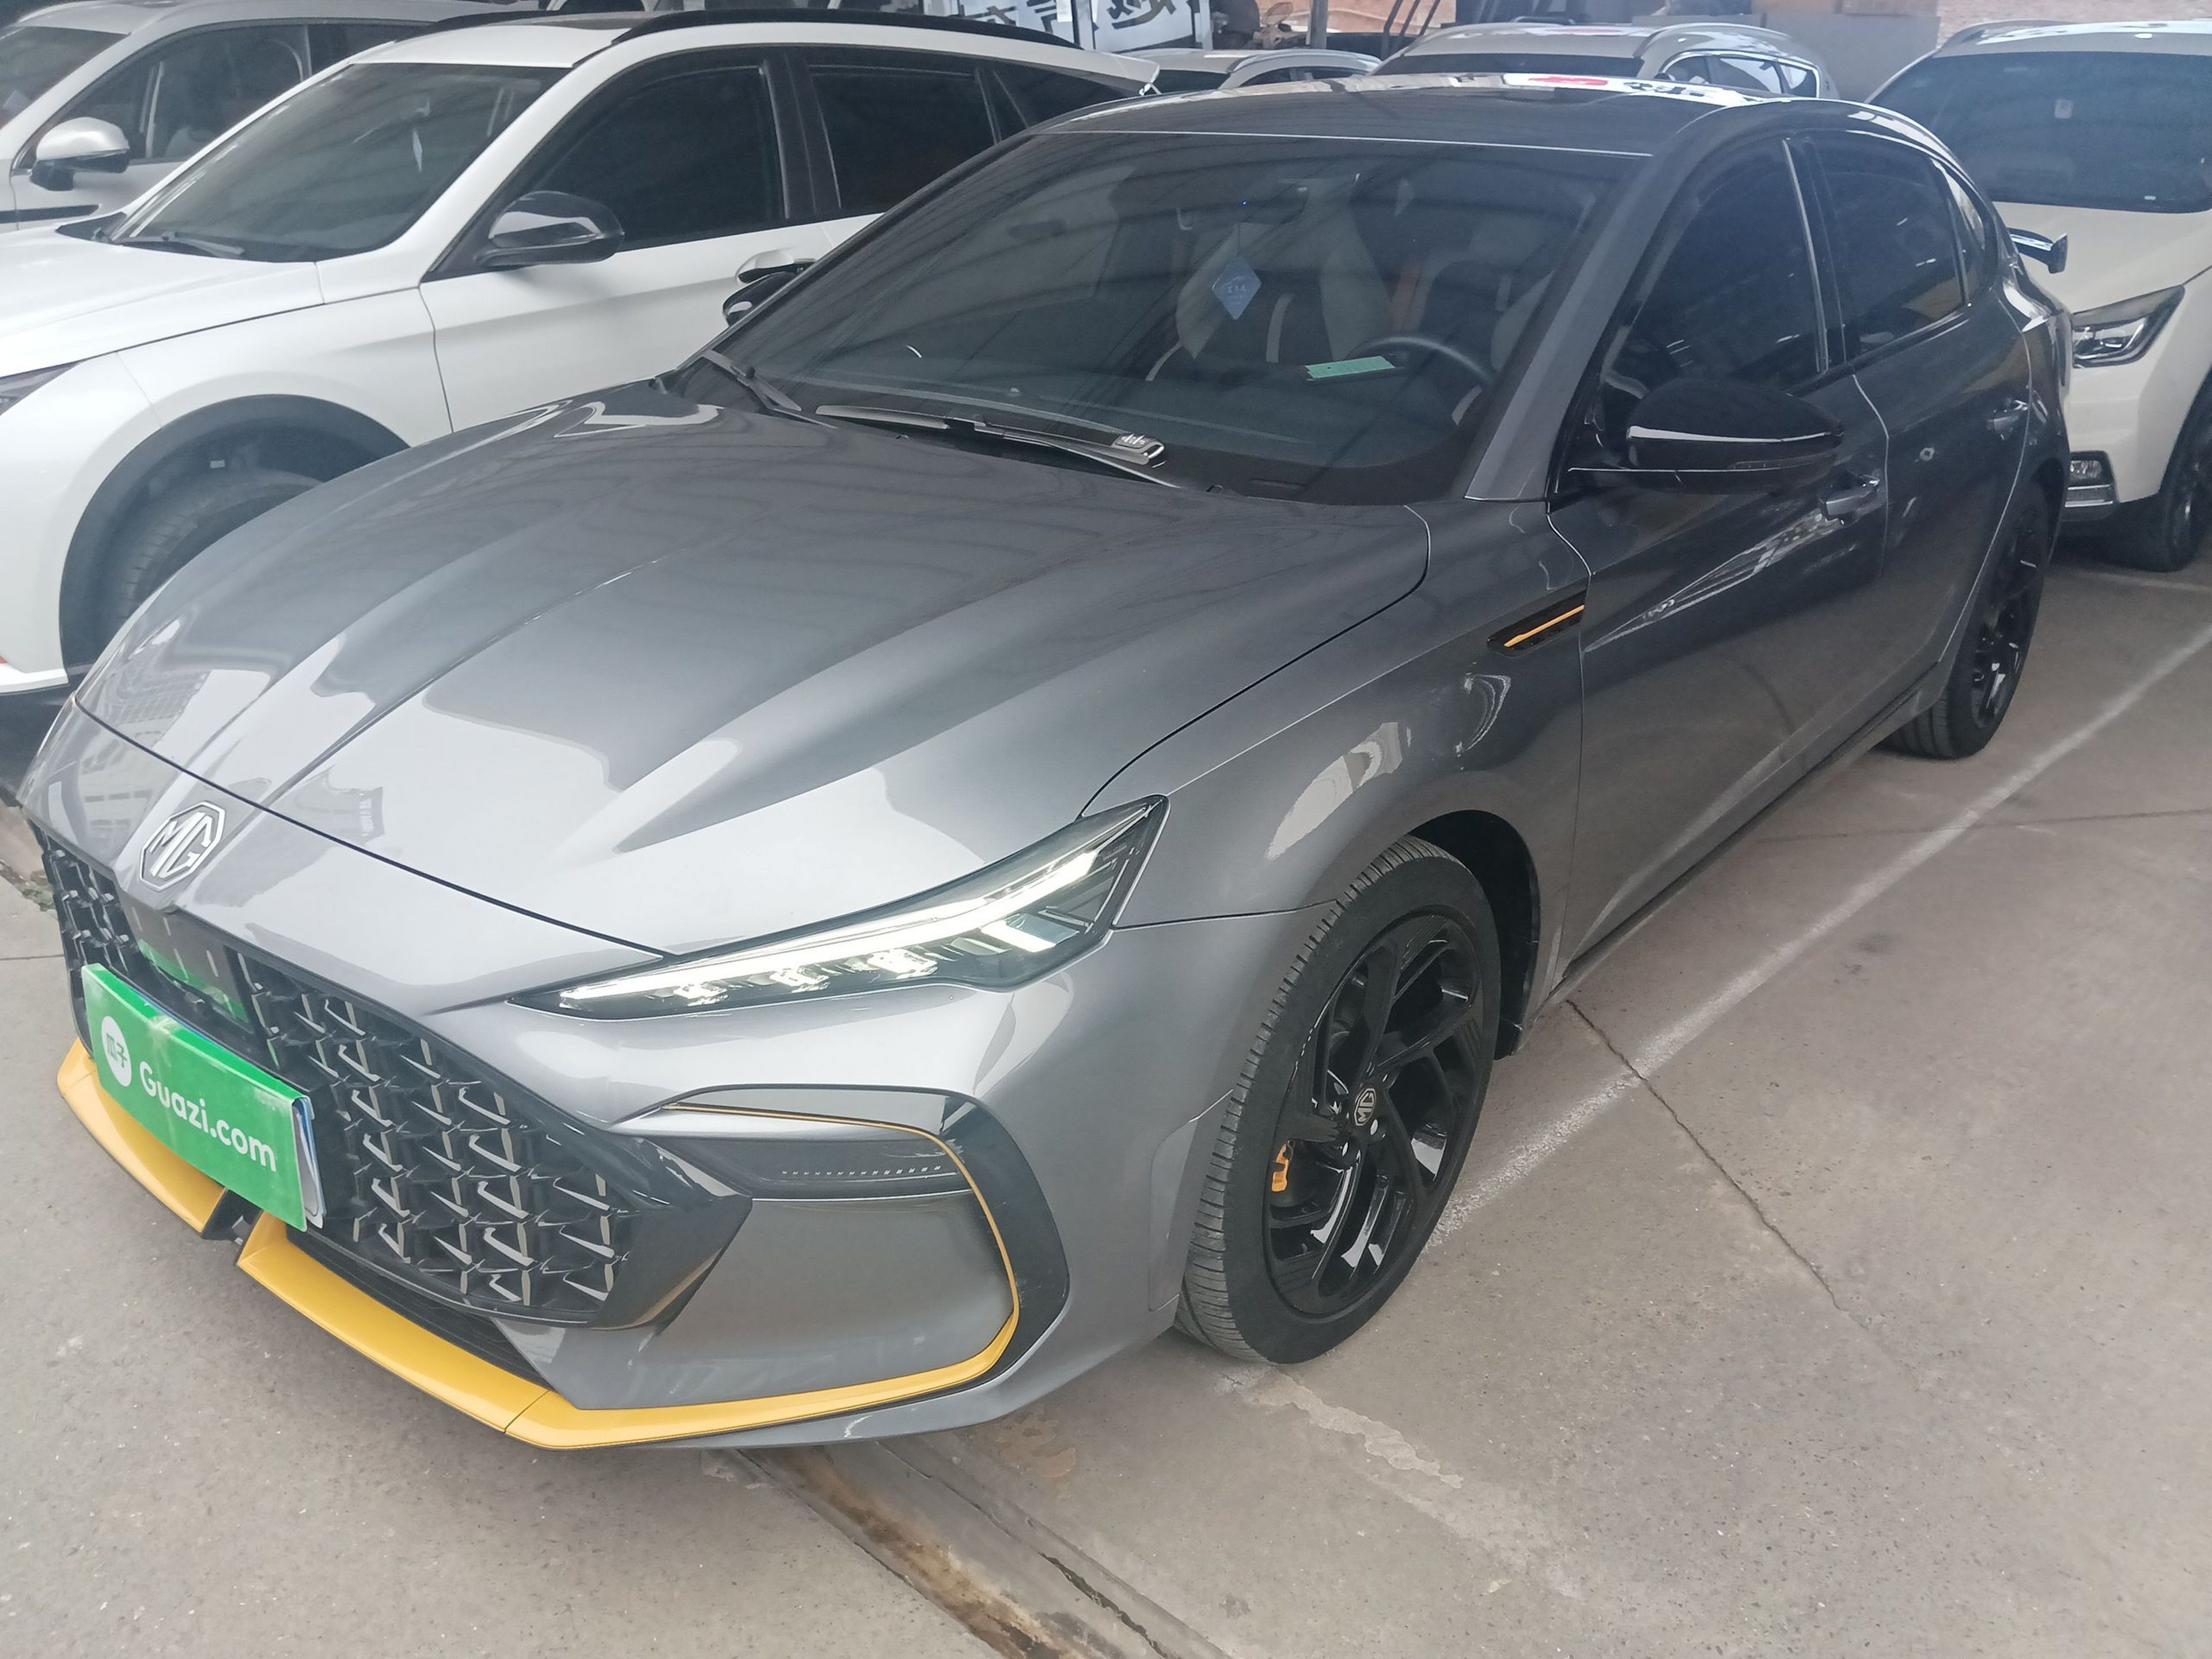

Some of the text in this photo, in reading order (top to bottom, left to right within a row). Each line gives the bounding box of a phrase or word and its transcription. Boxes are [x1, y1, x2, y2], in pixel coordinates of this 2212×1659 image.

[149, 811, 213, 878] MG
[139, 1061, 276, 1172] Guazi.com
[1357, 1092, 1374, 1123] MG
